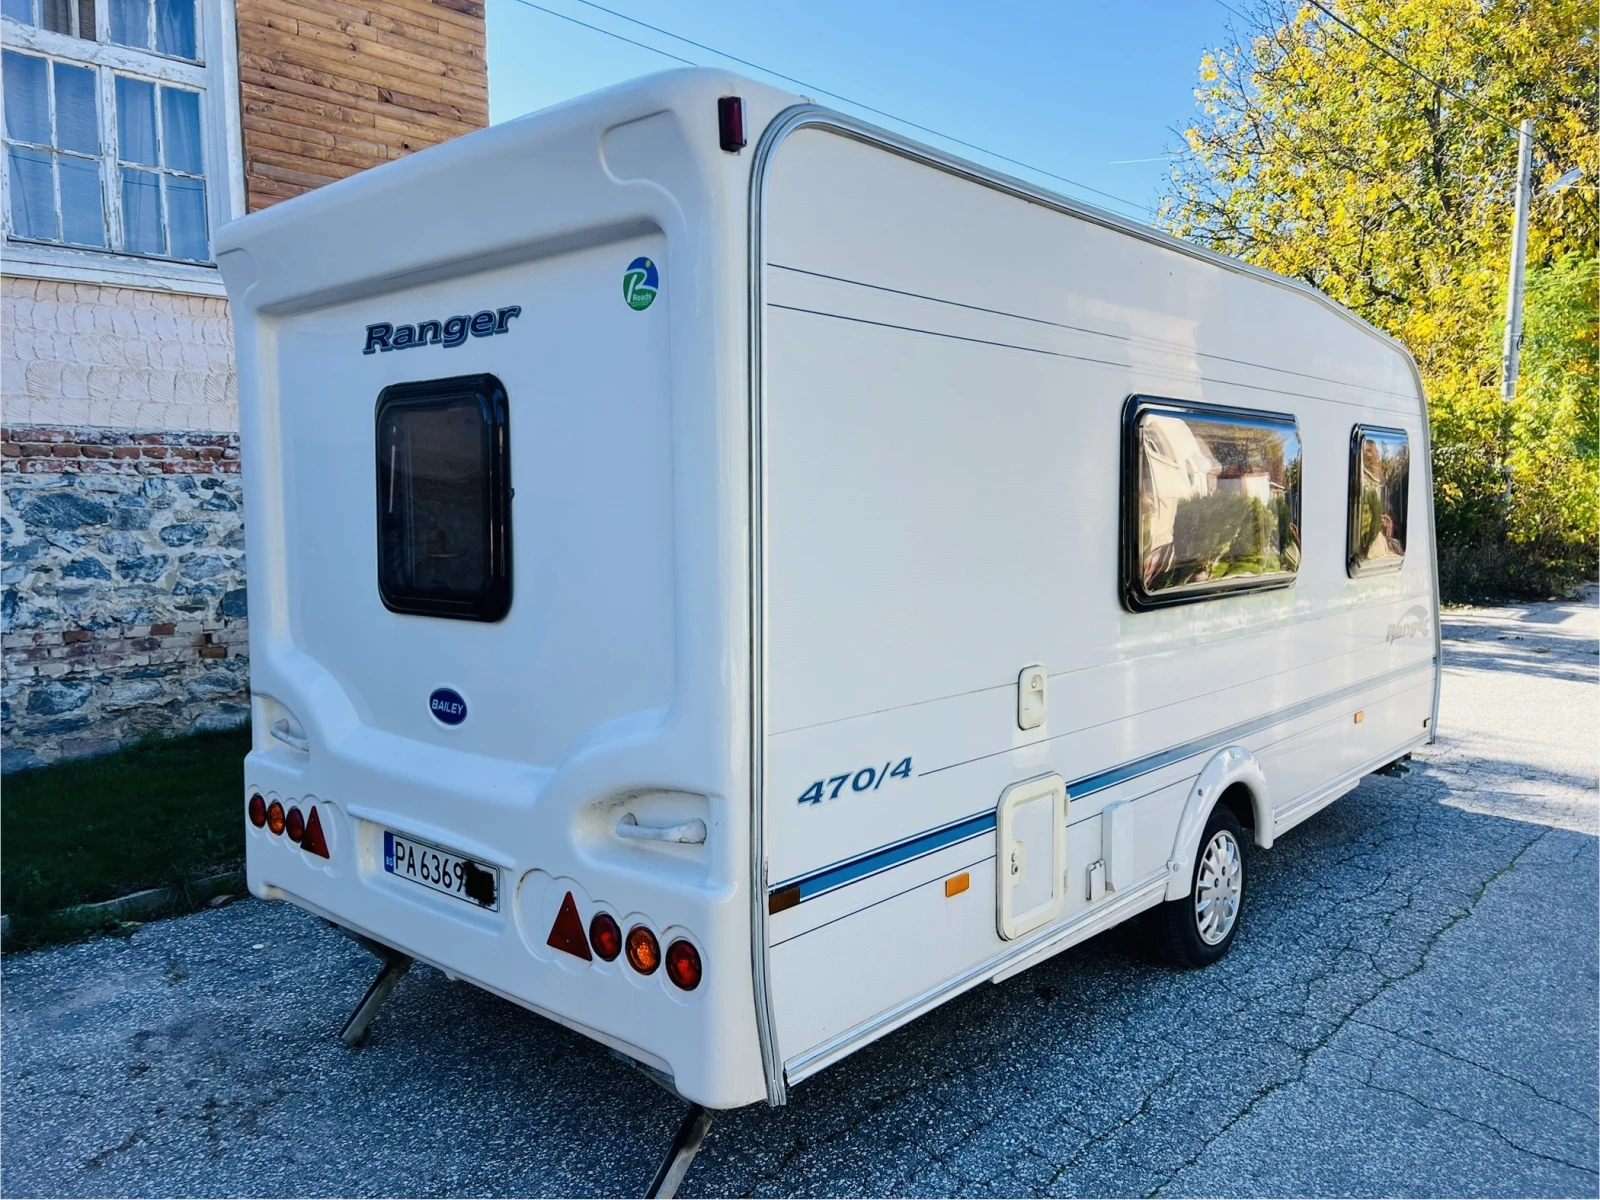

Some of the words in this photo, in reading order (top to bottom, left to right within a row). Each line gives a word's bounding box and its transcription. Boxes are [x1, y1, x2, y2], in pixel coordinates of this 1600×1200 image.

[362, 305, 522, 355] Ranger
[431, 698, 464, 715] BAILEY
[796, 755, 914, 807] 470/4
